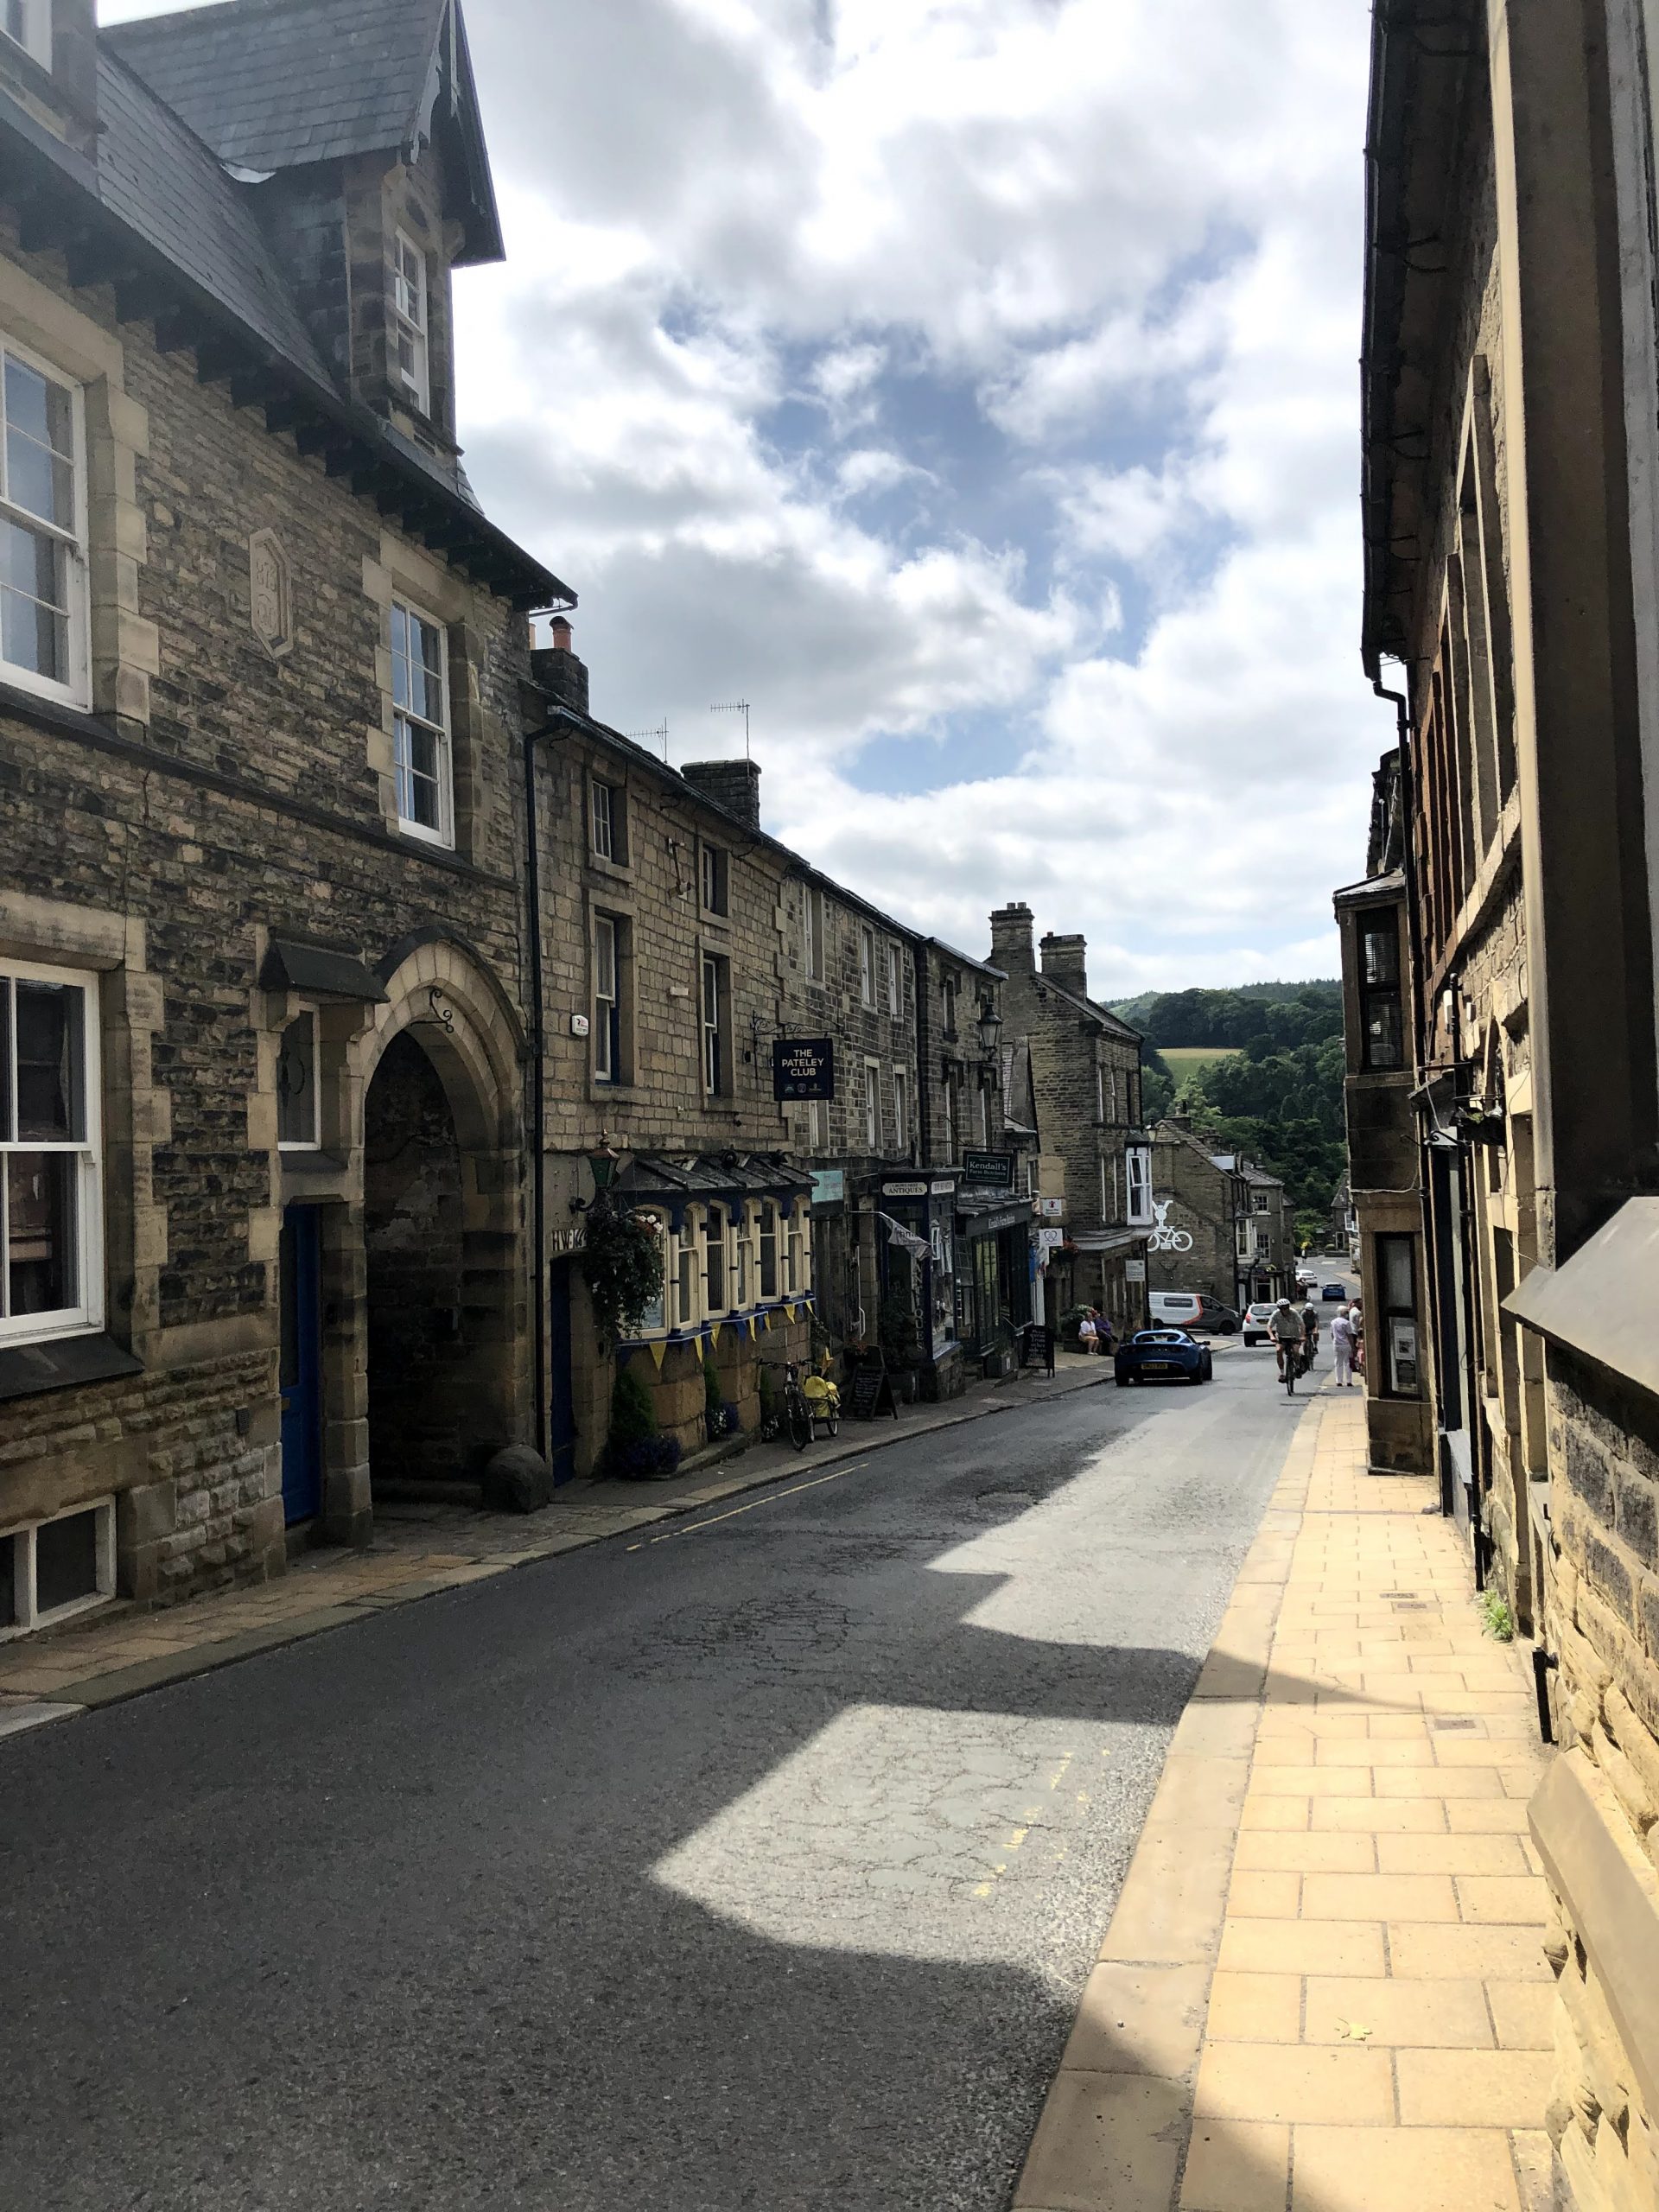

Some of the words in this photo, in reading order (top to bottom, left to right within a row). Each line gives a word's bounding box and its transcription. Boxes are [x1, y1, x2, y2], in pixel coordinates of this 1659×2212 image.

[793, 1048, 813, 1058] THE
[781, 1058, 825, 1067] PATELEY
[790, 1067, 817, 1077] CLUB
[969, 1160, 1007, 1172] Kendall's
